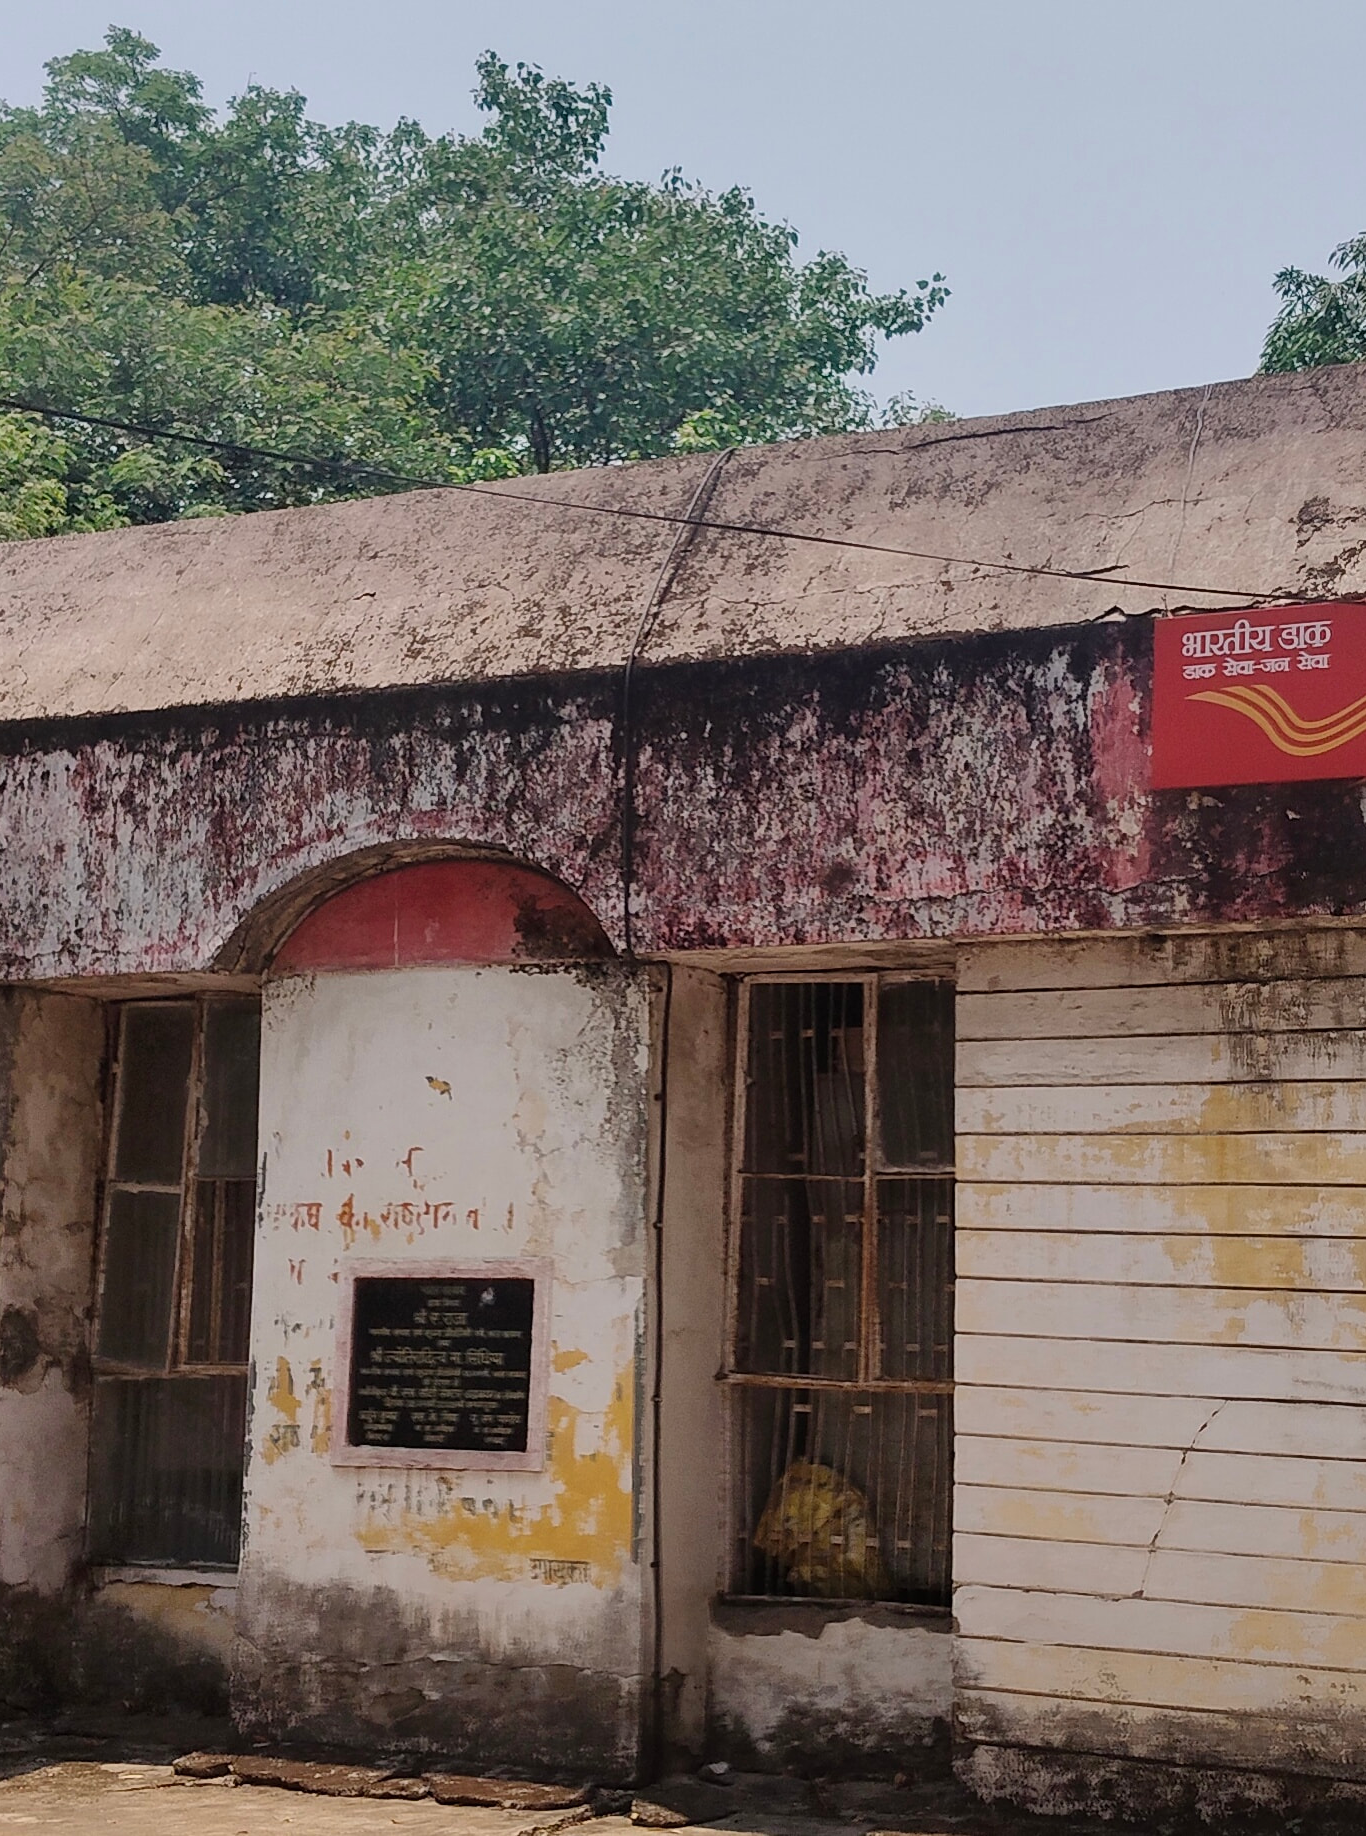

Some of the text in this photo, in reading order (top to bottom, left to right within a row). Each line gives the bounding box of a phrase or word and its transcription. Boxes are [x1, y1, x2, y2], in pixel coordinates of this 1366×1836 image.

[1182, 619, 1333, 657] भारतीय डाक
[1182, 663, 1217, 679] डाक
[1296, 651, 1332, 670] सेवा
